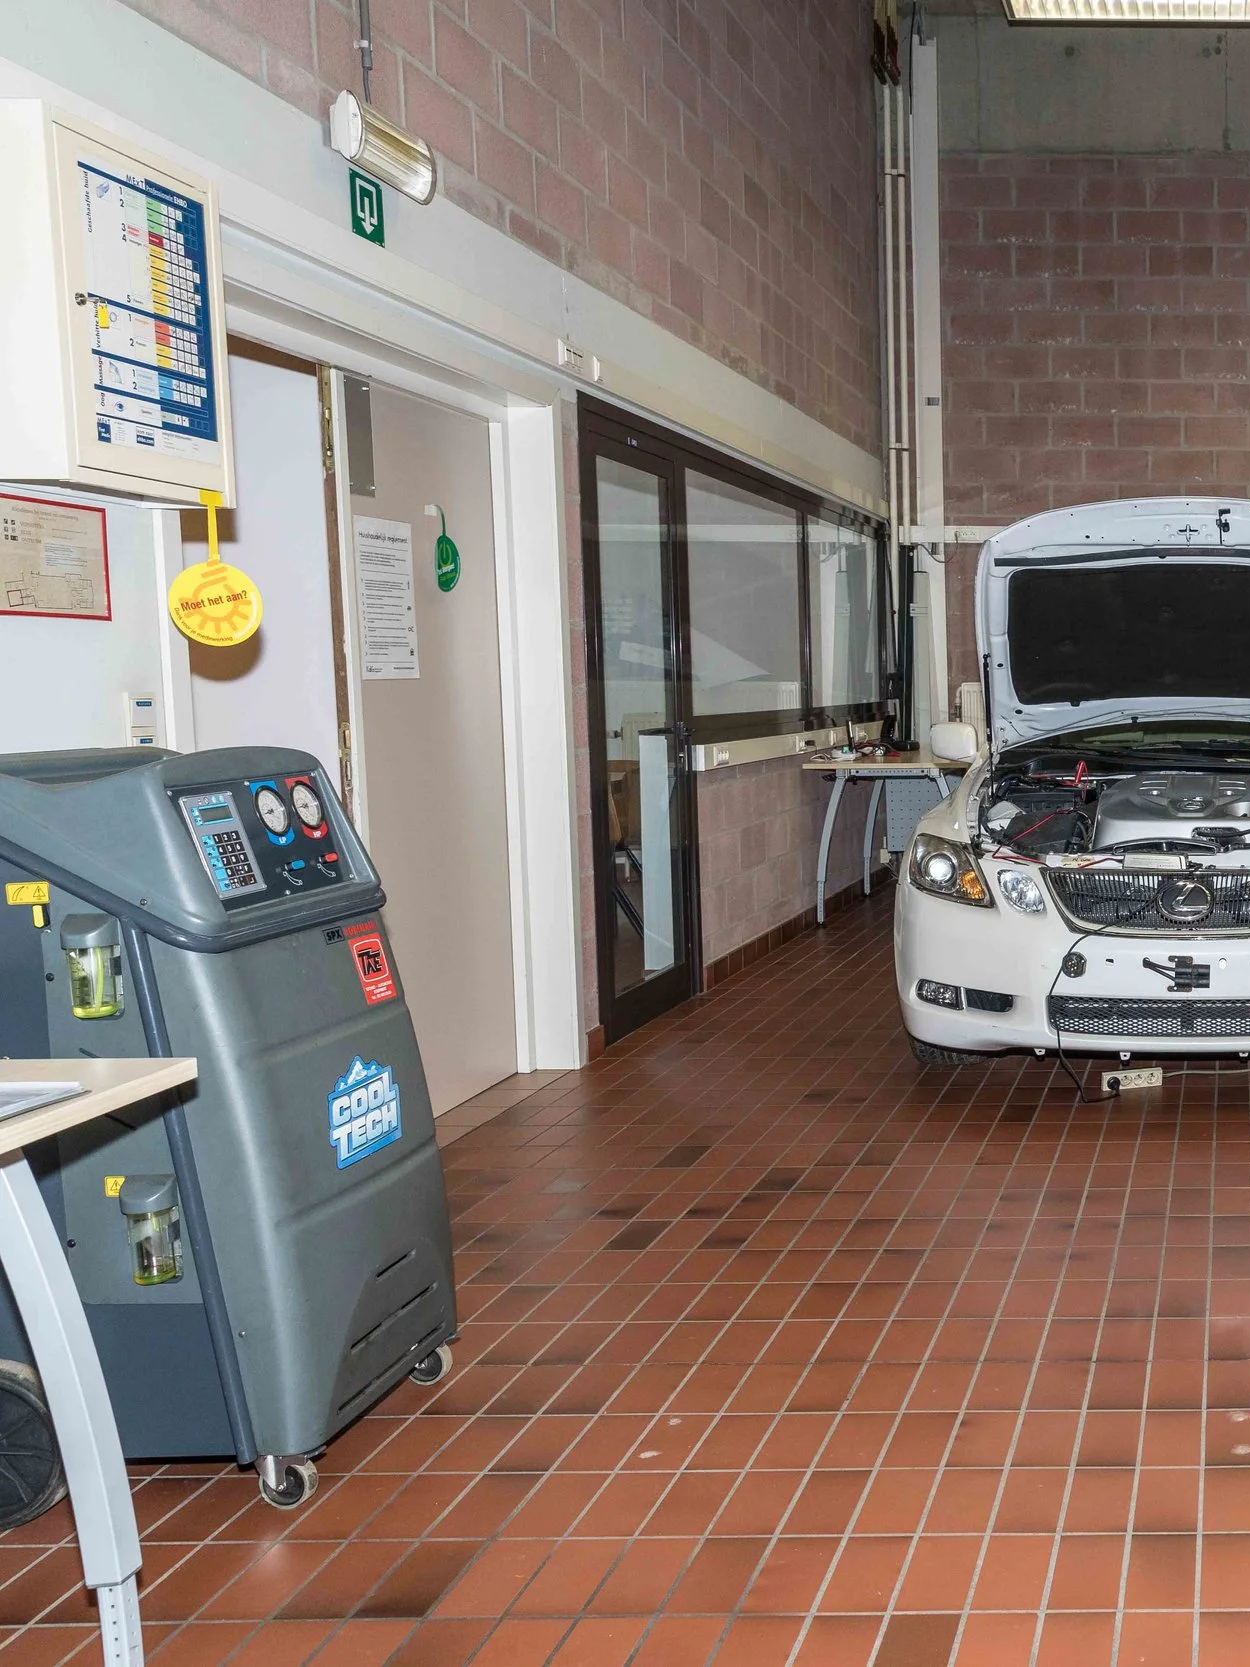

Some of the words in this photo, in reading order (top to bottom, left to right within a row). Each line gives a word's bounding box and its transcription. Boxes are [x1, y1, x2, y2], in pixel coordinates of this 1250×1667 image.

[119, 186, 123, 195] 1
[120, 198, 125, 208] 2
[173, 196, 188, 208] EHBO
[121, 222, 127, 232] 3
[122, 234, 127, 243] 4
[126, 294, 131, 303] 5
[129, 313, 132, 322] 1
[130, 338, 135, 347] 2
[132, 369, 136, 377] 1
[133, 382, 138, 391] 2
[181, 600, 206, 612] Moet
[207, 595, 224, 607] het
[226, 590, 248, 602] aan?
[196, 632, 233, 642] medewerking
[326, 929, 343, 942] SPX
[332, 1071, 397, 1127] COOL
[333, 1100, 398, 1161] TECH
